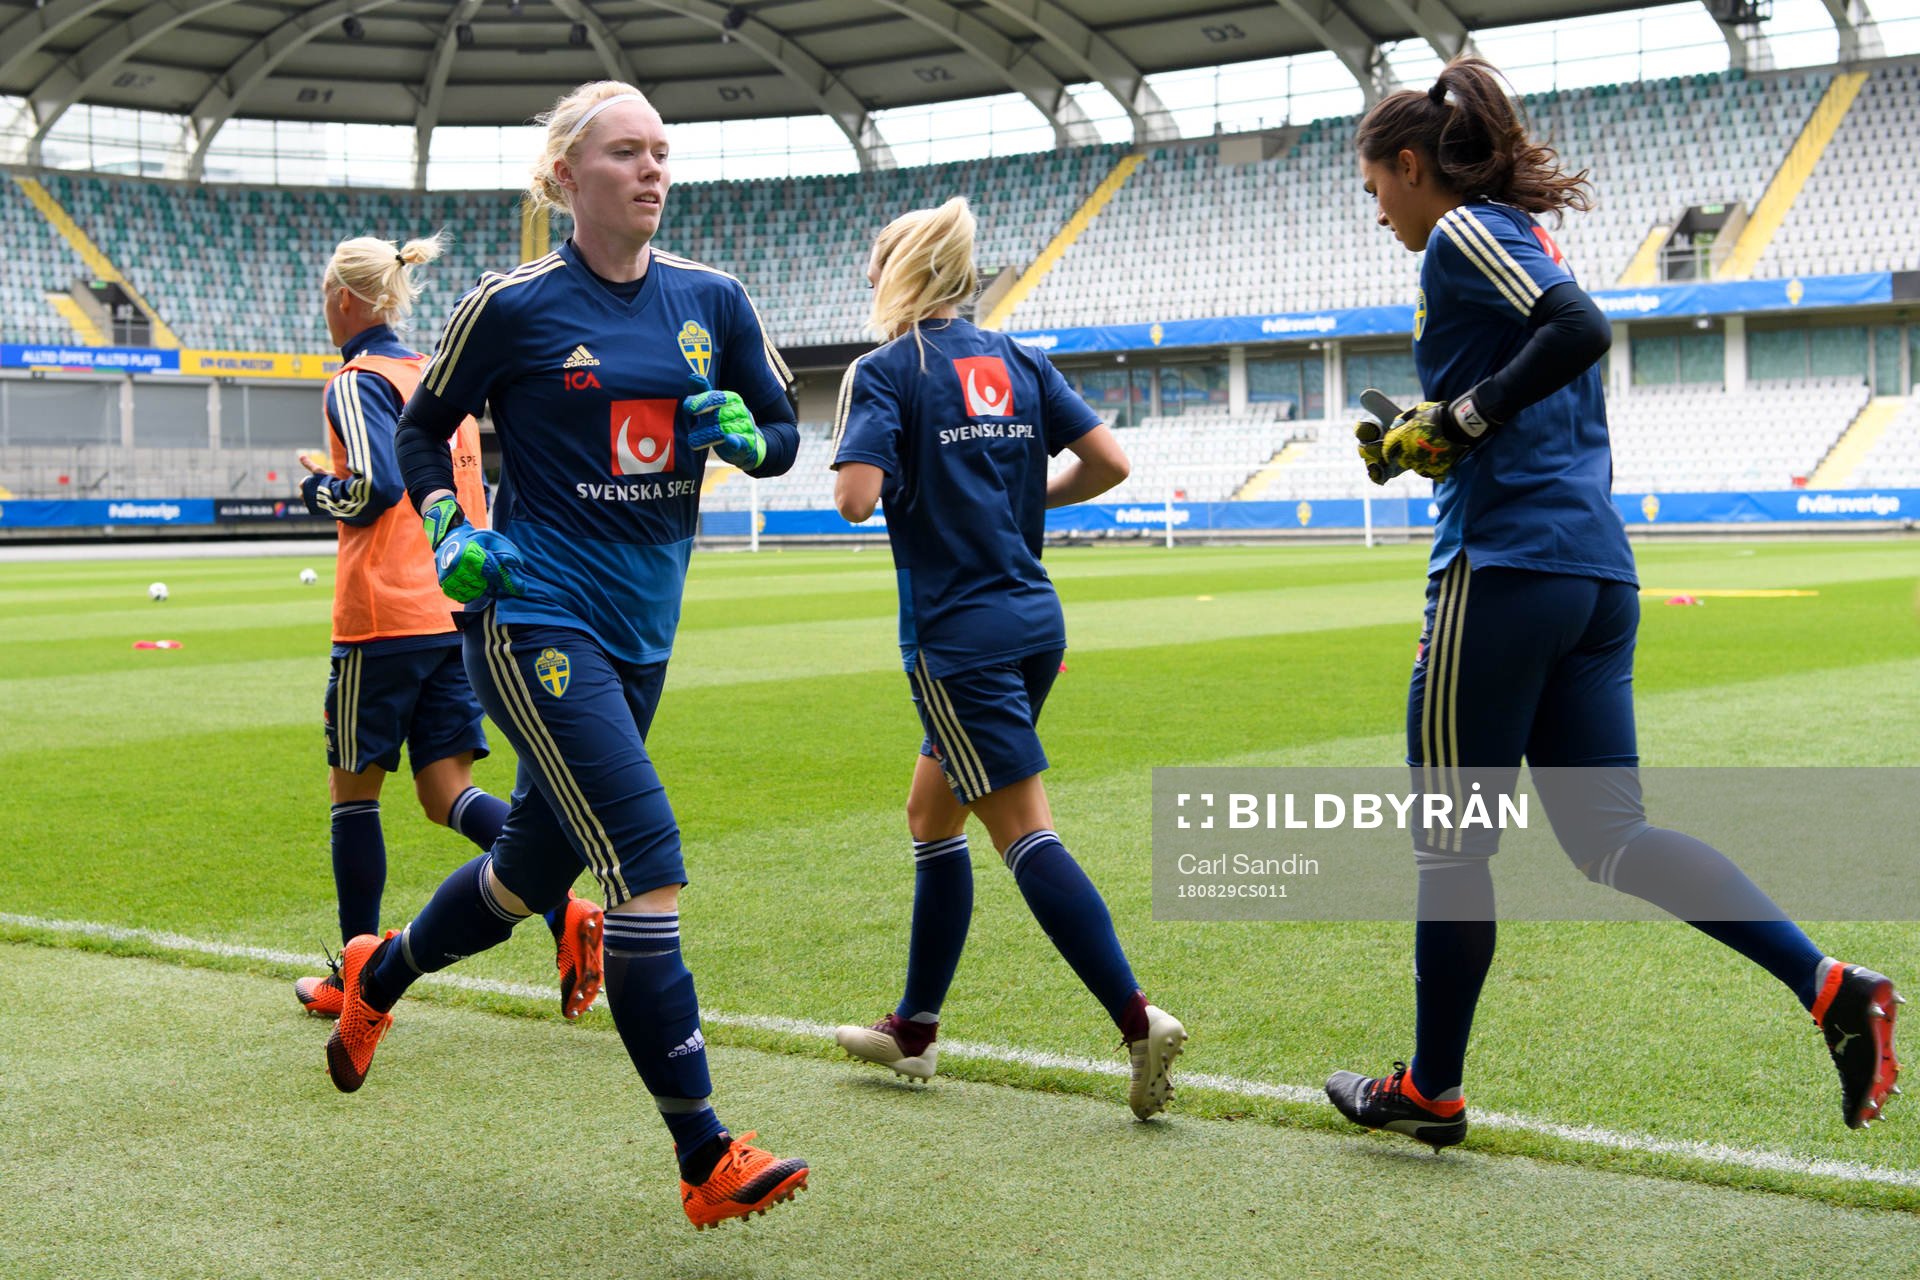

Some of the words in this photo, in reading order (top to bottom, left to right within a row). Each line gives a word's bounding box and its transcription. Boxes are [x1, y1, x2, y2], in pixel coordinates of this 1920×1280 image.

[1200, 24, 1247, 43] D3
[913, 66, 956, 83] D2
[296, 87, 334, 104] B1
[718, 86, 755, 102] D1
[22, 350, 57, 364] ALLTID
[95, 352, 129, 366] ALLTID
[562, 358, 601, 369] adidas
[564, 371, 602, 391] ICA
[939, 422, 1005, 445] SVENSKA
[575, 482, 663, 502] SVENSKA
[667, 479, 697, 499] SPEL
[667, 1040, 705, 1058] adida
